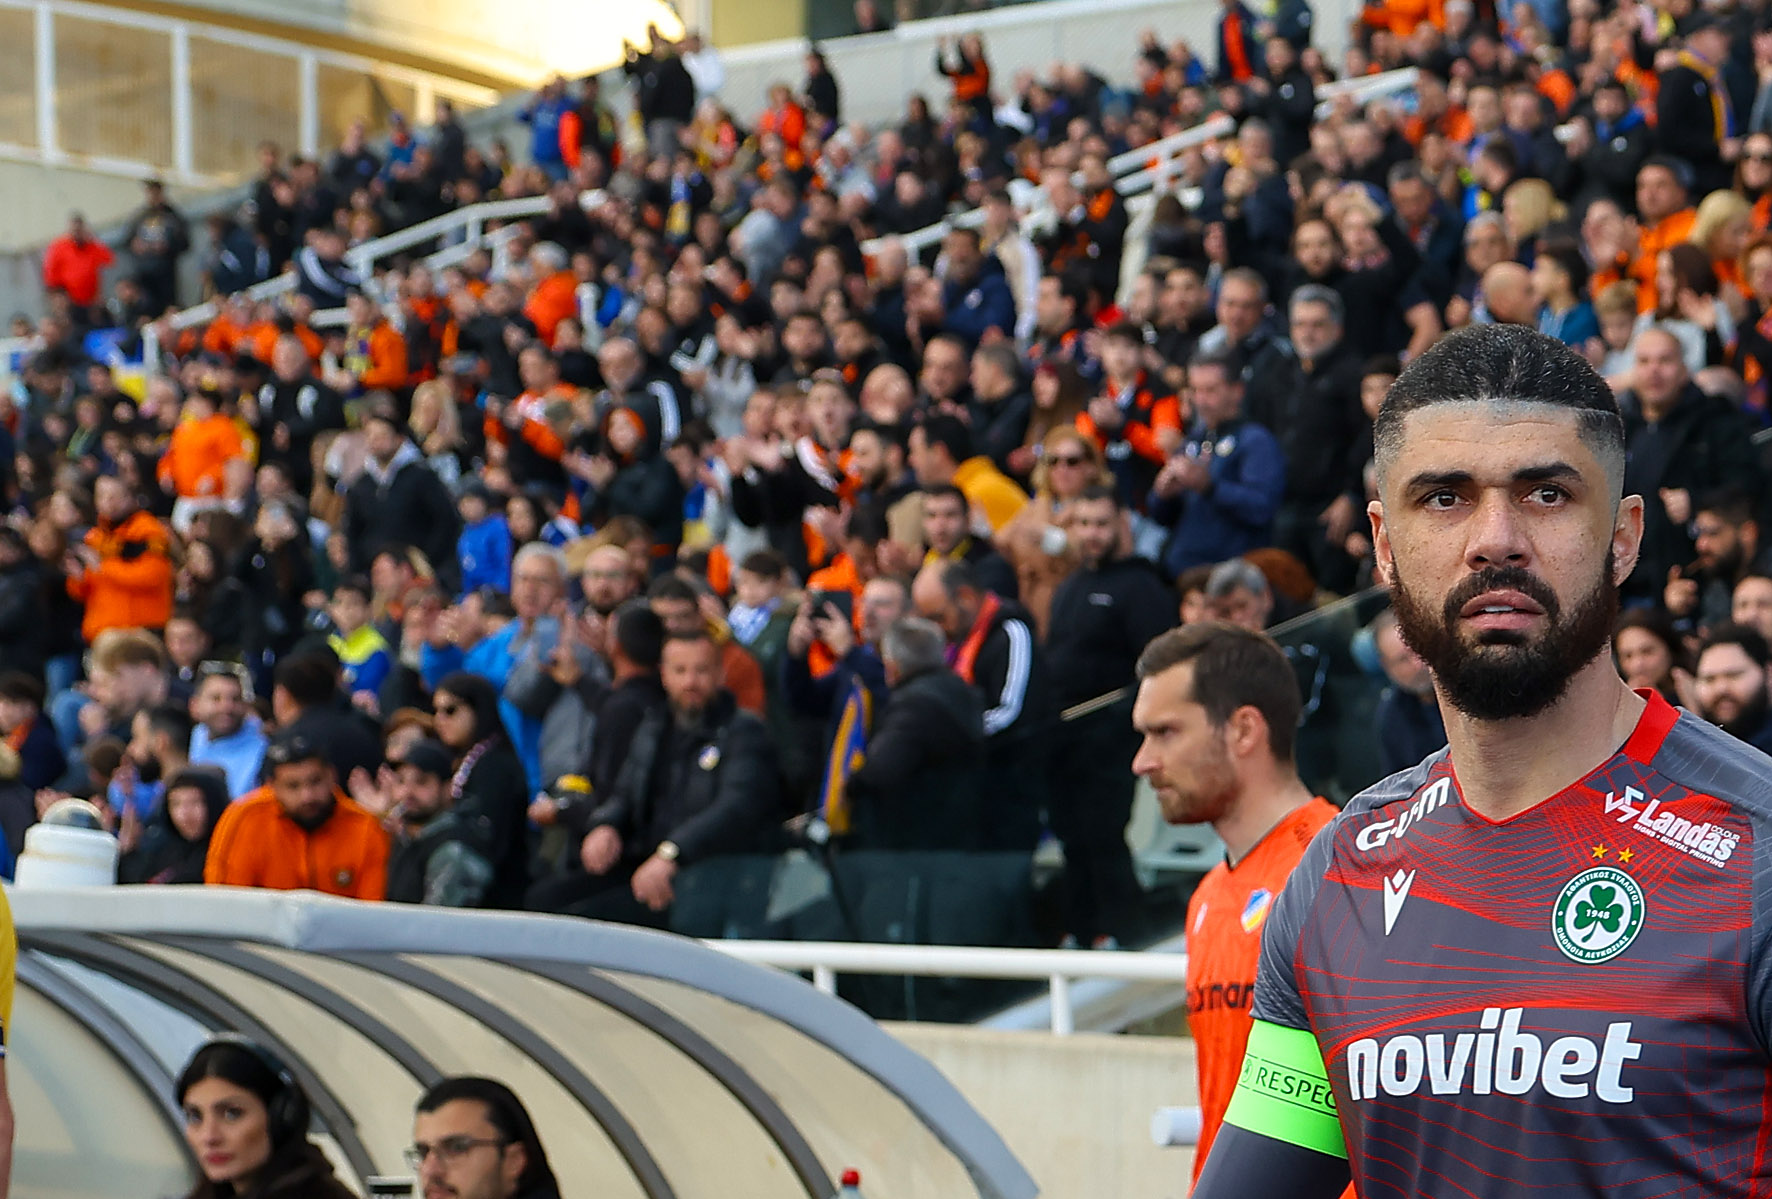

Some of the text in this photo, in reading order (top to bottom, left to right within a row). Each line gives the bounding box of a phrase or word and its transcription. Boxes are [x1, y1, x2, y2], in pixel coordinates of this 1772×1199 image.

[1637, 798, 1736, 861] Landas
[1586, 909, 1611, 919] 1948
[1347, 1007, 1643, 1103] novibet
